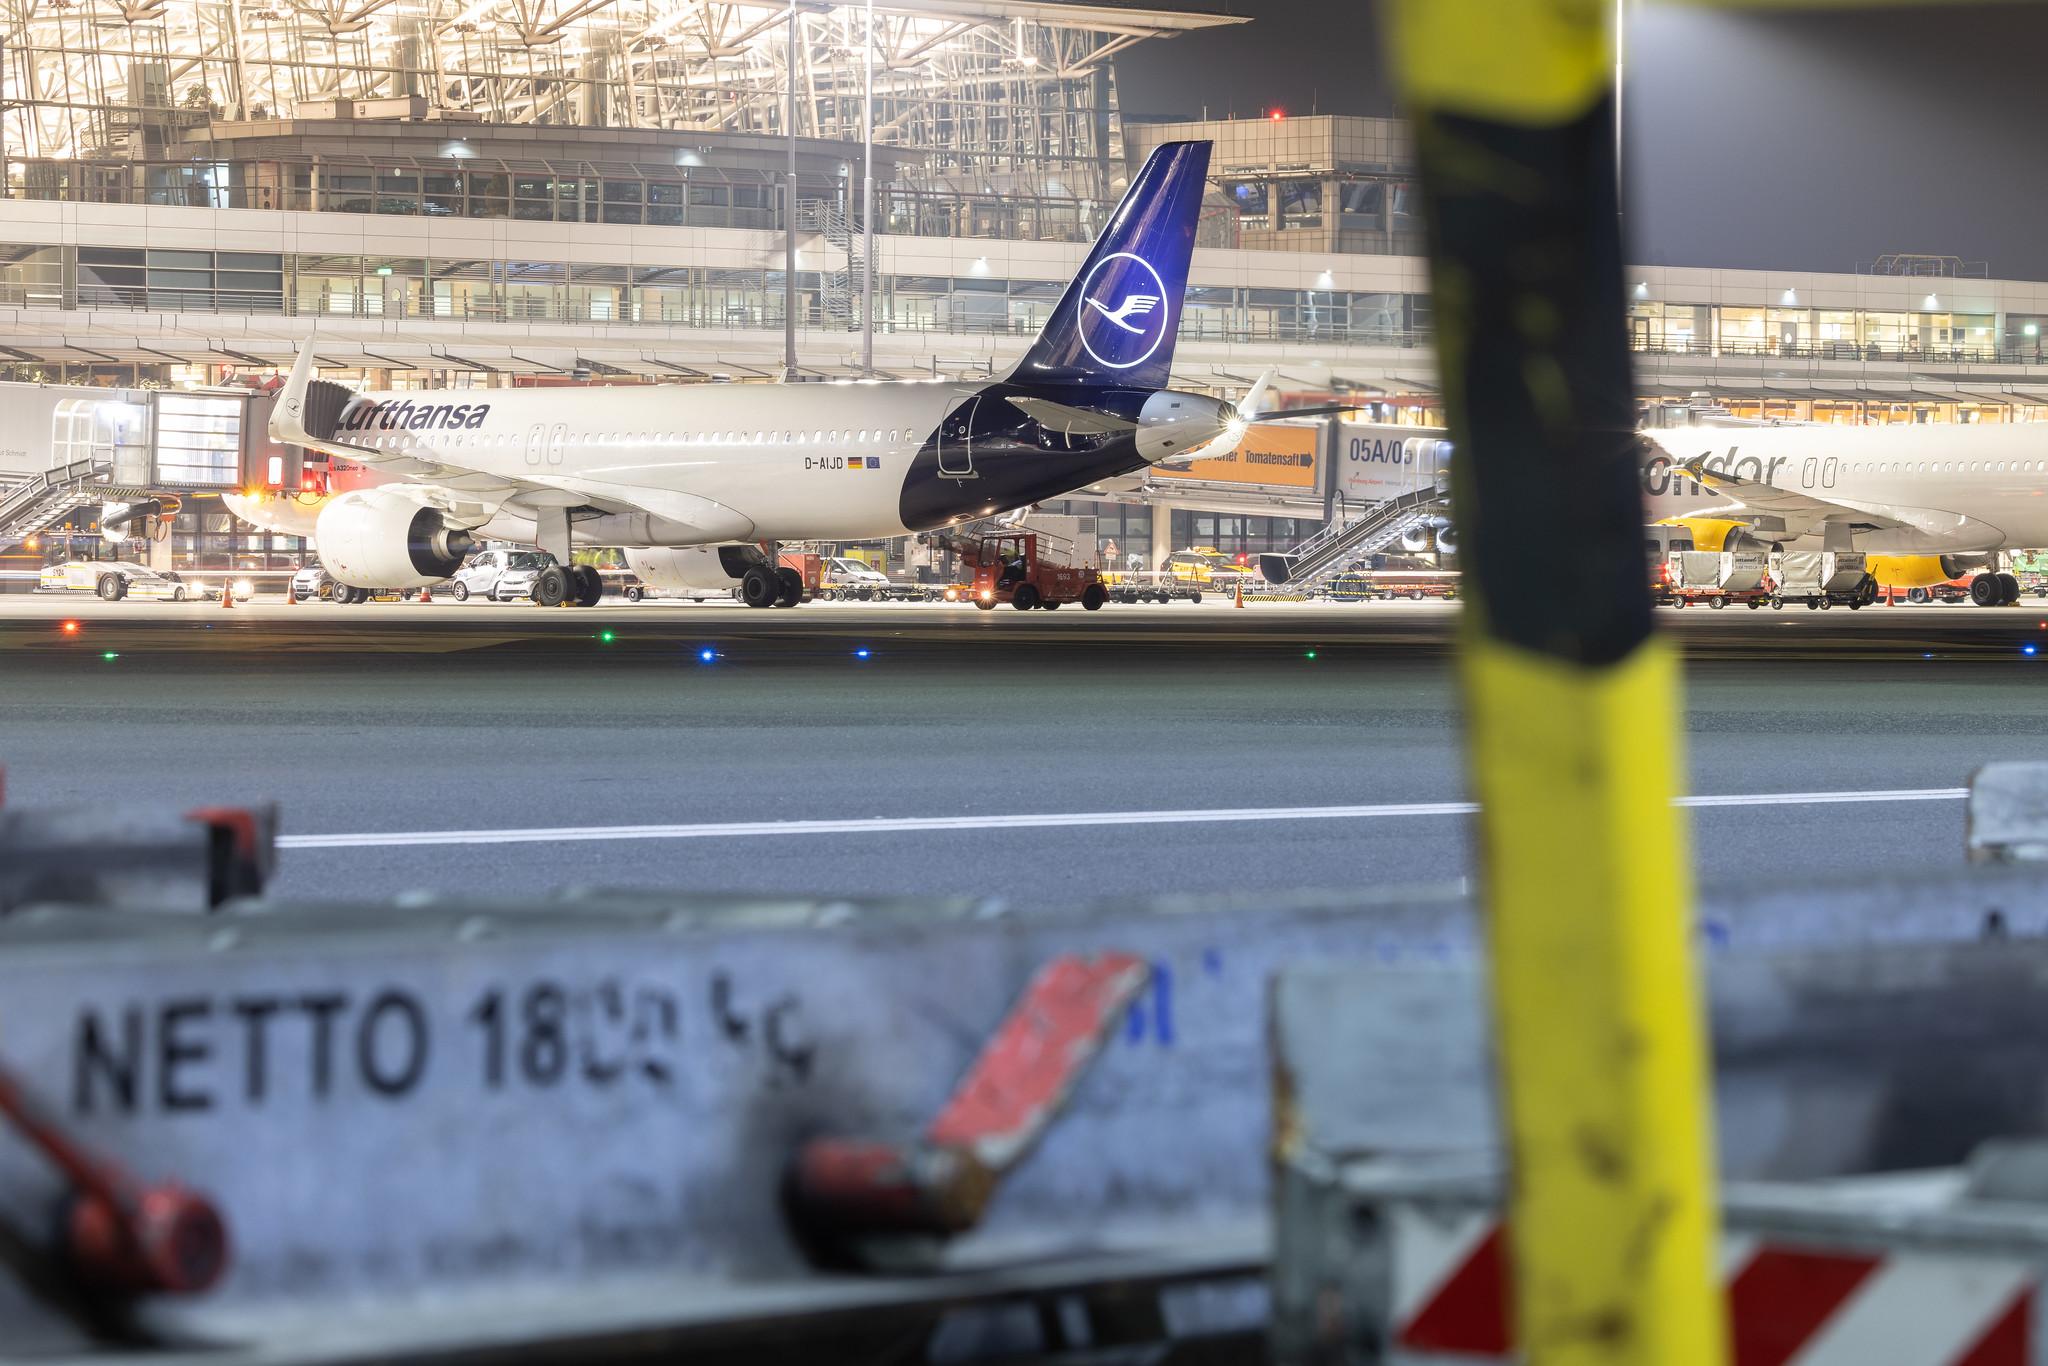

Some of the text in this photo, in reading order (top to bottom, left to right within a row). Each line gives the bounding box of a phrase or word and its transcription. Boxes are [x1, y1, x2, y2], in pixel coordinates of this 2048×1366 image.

[804, 456, 844, 470] D-AIJD
[1245, 450, 1300, 467] Tomatensaft
[1643, 446, 1787, 497] ondor
[75, 984, 431, 1118] NETTO
